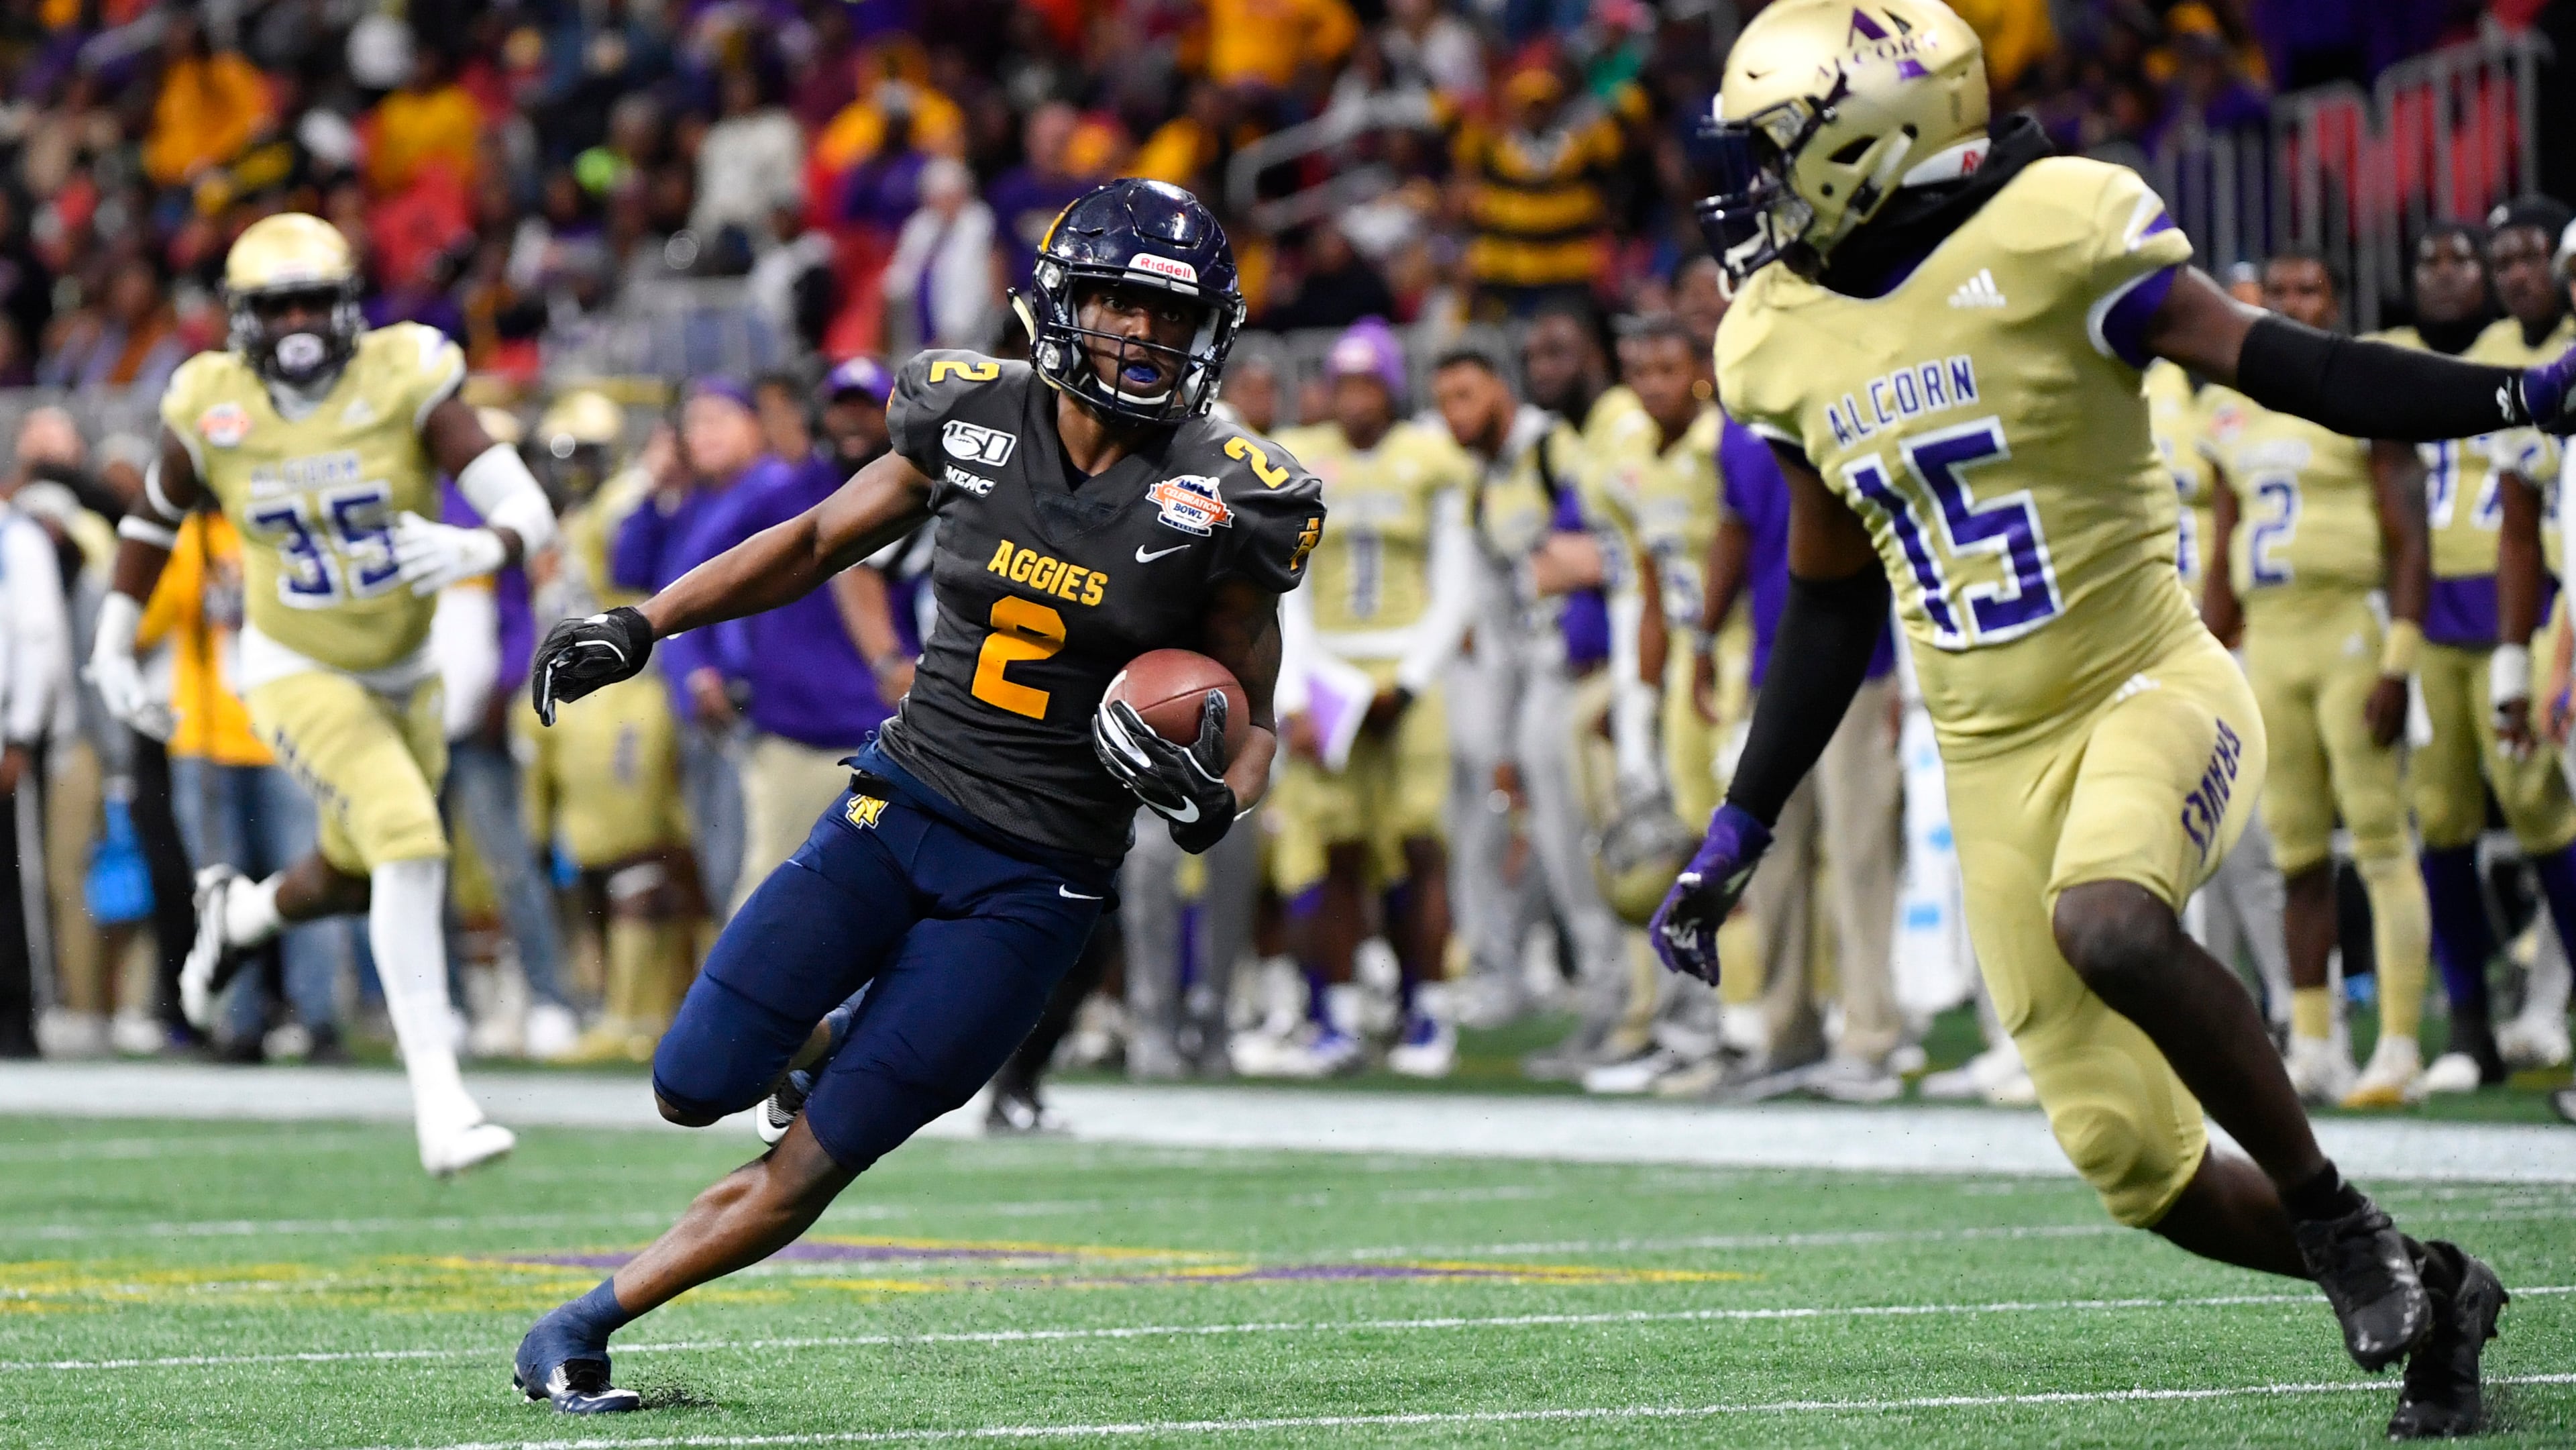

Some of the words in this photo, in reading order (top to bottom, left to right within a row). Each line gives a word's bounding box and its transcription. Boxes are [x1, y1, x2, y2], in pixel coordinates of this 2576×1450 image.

[1140, 258, 1191, 279] Riddell
[929, 360, 1001, 383] 2
[1827, 358, 1977, 447] ALCORN
[943, 421, 1016, 466] 150
[1224, 435, 1290, 490] 2
[945, 464, 996, 495] MEAC
[1163, 486, 1222, 513] CELEBRATION
[1173, 503, 1203, 520] BOWL
[1842, 415, 2064, 648] 15
[2251, 472, 2301, 584] 2
[248, 486, 398, 604] 35
[987, 539, 1109, 607] AGGIES
[971, 595, 1067, 720] 2
